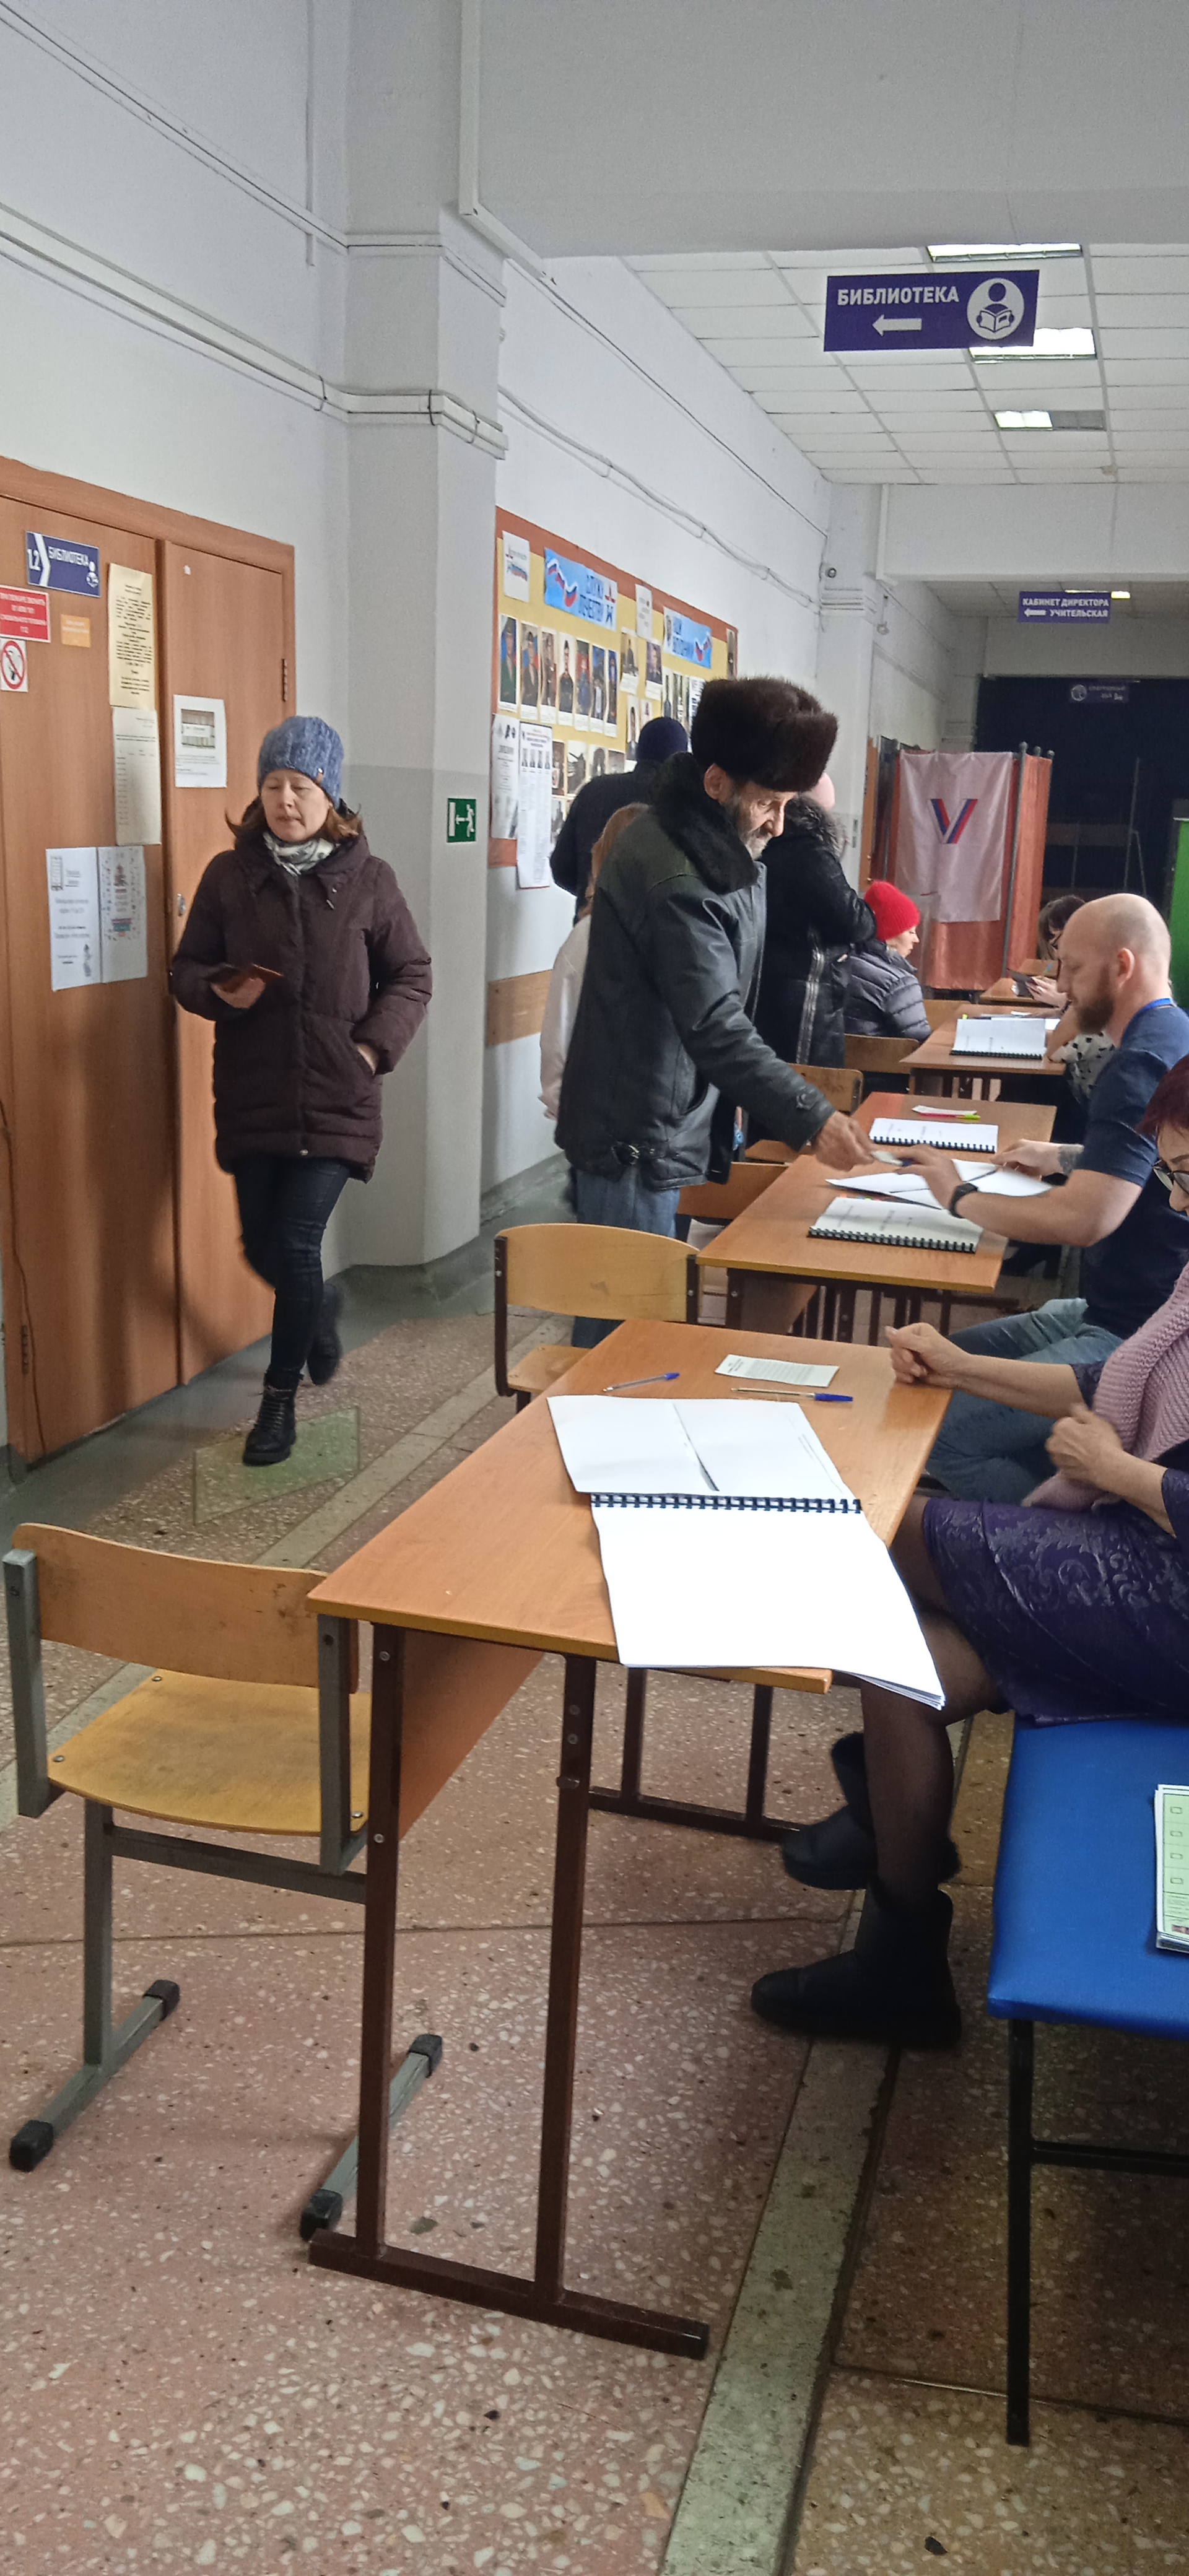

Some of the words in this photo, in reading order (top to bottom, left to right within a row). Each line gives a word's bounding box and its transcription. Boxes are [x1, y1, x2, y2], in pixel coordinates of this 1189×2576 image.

[837, 286, 959, 305] БИБЛИОТЕКА
[27, 549, 41, 571] 12
[1061, 599, 1109, 607] ДИРЕКТОРА
